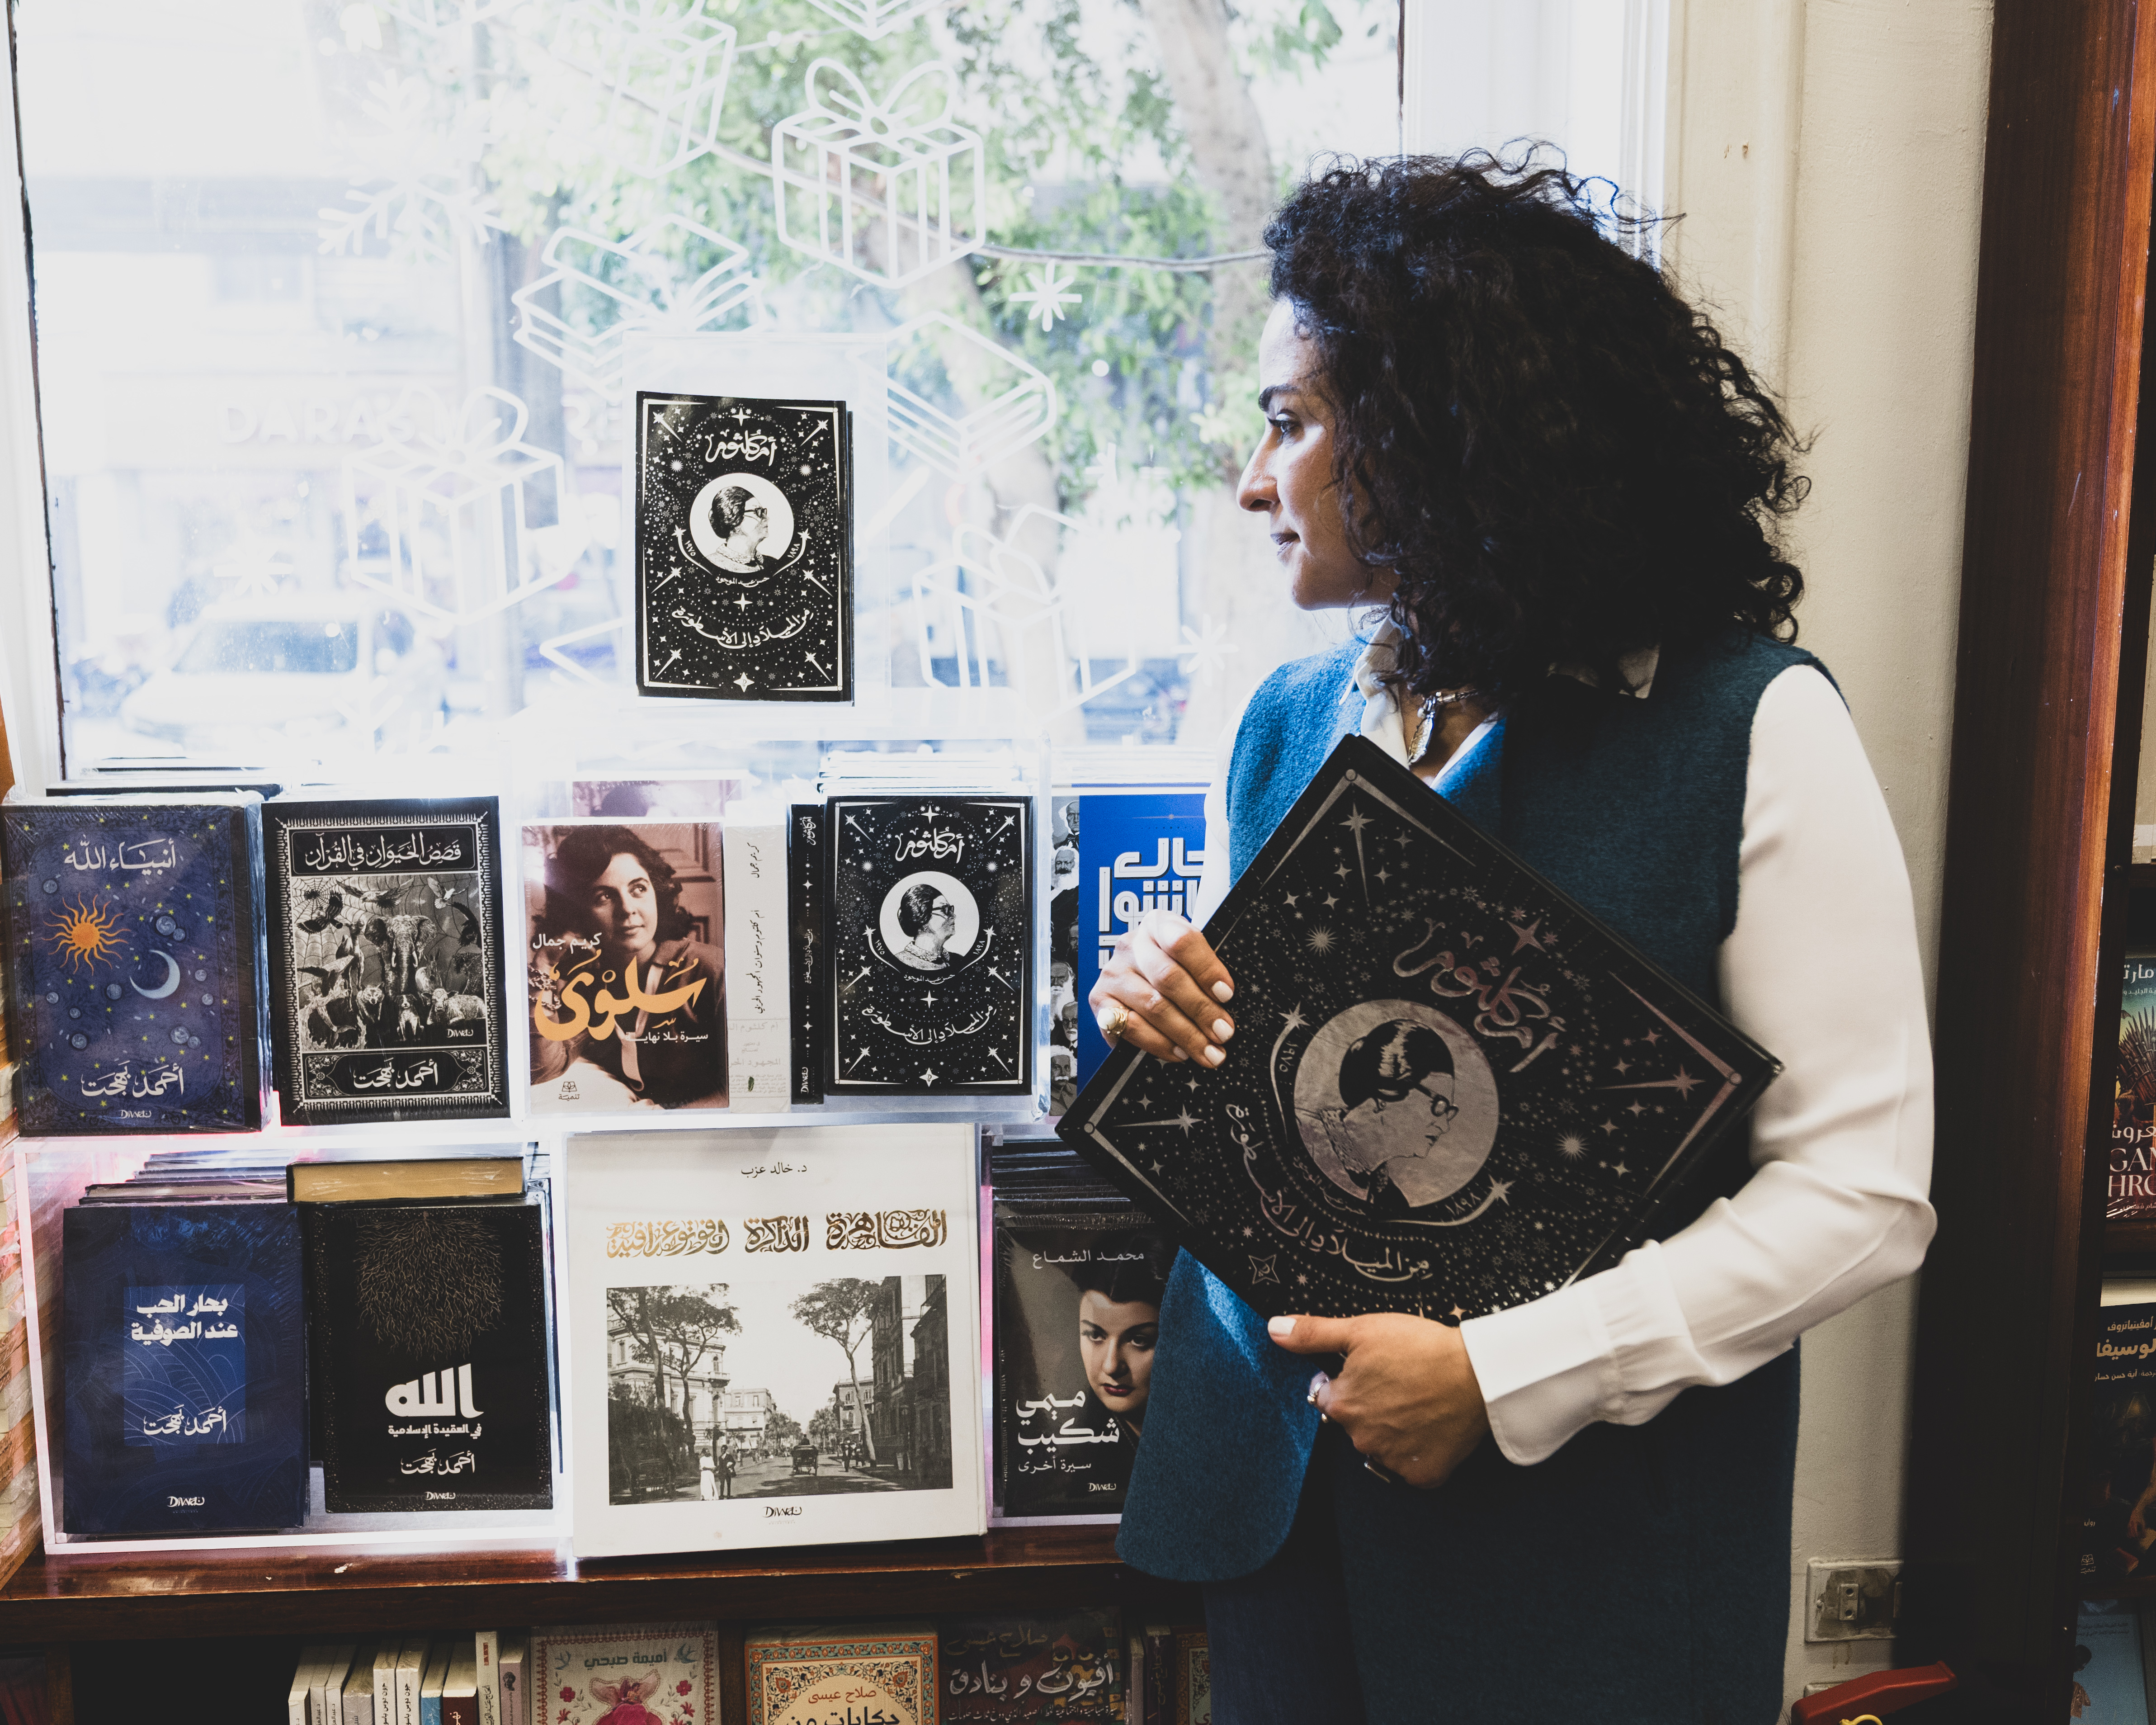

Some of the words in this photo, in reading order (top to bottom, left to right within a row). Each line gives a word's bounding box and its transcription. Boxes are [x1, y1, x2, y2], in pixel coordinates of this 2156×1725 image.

[747, 842, 763, 861] كريم
[749, 862, 760, 879] جمال
[750, 909, 765, 919] أم
[750, 920, 765, 940] كلثوم
[533, 935, 566, 949] جمال
[570, 932, 602, 954] كريم
[626, 1031, 660, 1043] نهاية
[662, 1031, 679, 1042] بلا
[680, 1031, 708, 1042] سيرة
[741, 1165, 767, 1178] عزب
[770, 1162, 794, 1175] خالد
[797, 1166, 807, 1175] د.
[826, 1209, 948, 1250] القاهرة
[1033, 1248, 1091, 1269] الشماع
[1097, 1251, 1144, 1261] محمد
[137, 1294, 185, 1318] الحب
[187, 1294, 228, 1317] بحار
[131, 1321, 202, 1346] الصوفية
[205, 1323, 238, 1339] عند
[385, 1363, 484, 1418] الله
[1015, 1389, 1085, 1427] ميمي
[388, 1424, 433, 1439] الإسلامية
[434, 1423, 470, 1437] العقيدة
[470, 1423, 482, 1439] في
[1017, 1418, 1120, 1454] شكيب
[1018, 1456, 1057, 1473] أخرى
[1060, 1460, 1091, 1472] سيرة
[584, 1654, 628, 1670] صبحي
[633, 1649, 667, 1665] أميمة
[949, 1659, 1008, 1701] بنادق
[1013, 1674, 1032, 1699] و
[808, 1690, 841, 1704] عيسى
[845, 1686, 877, 1703] صلاح
